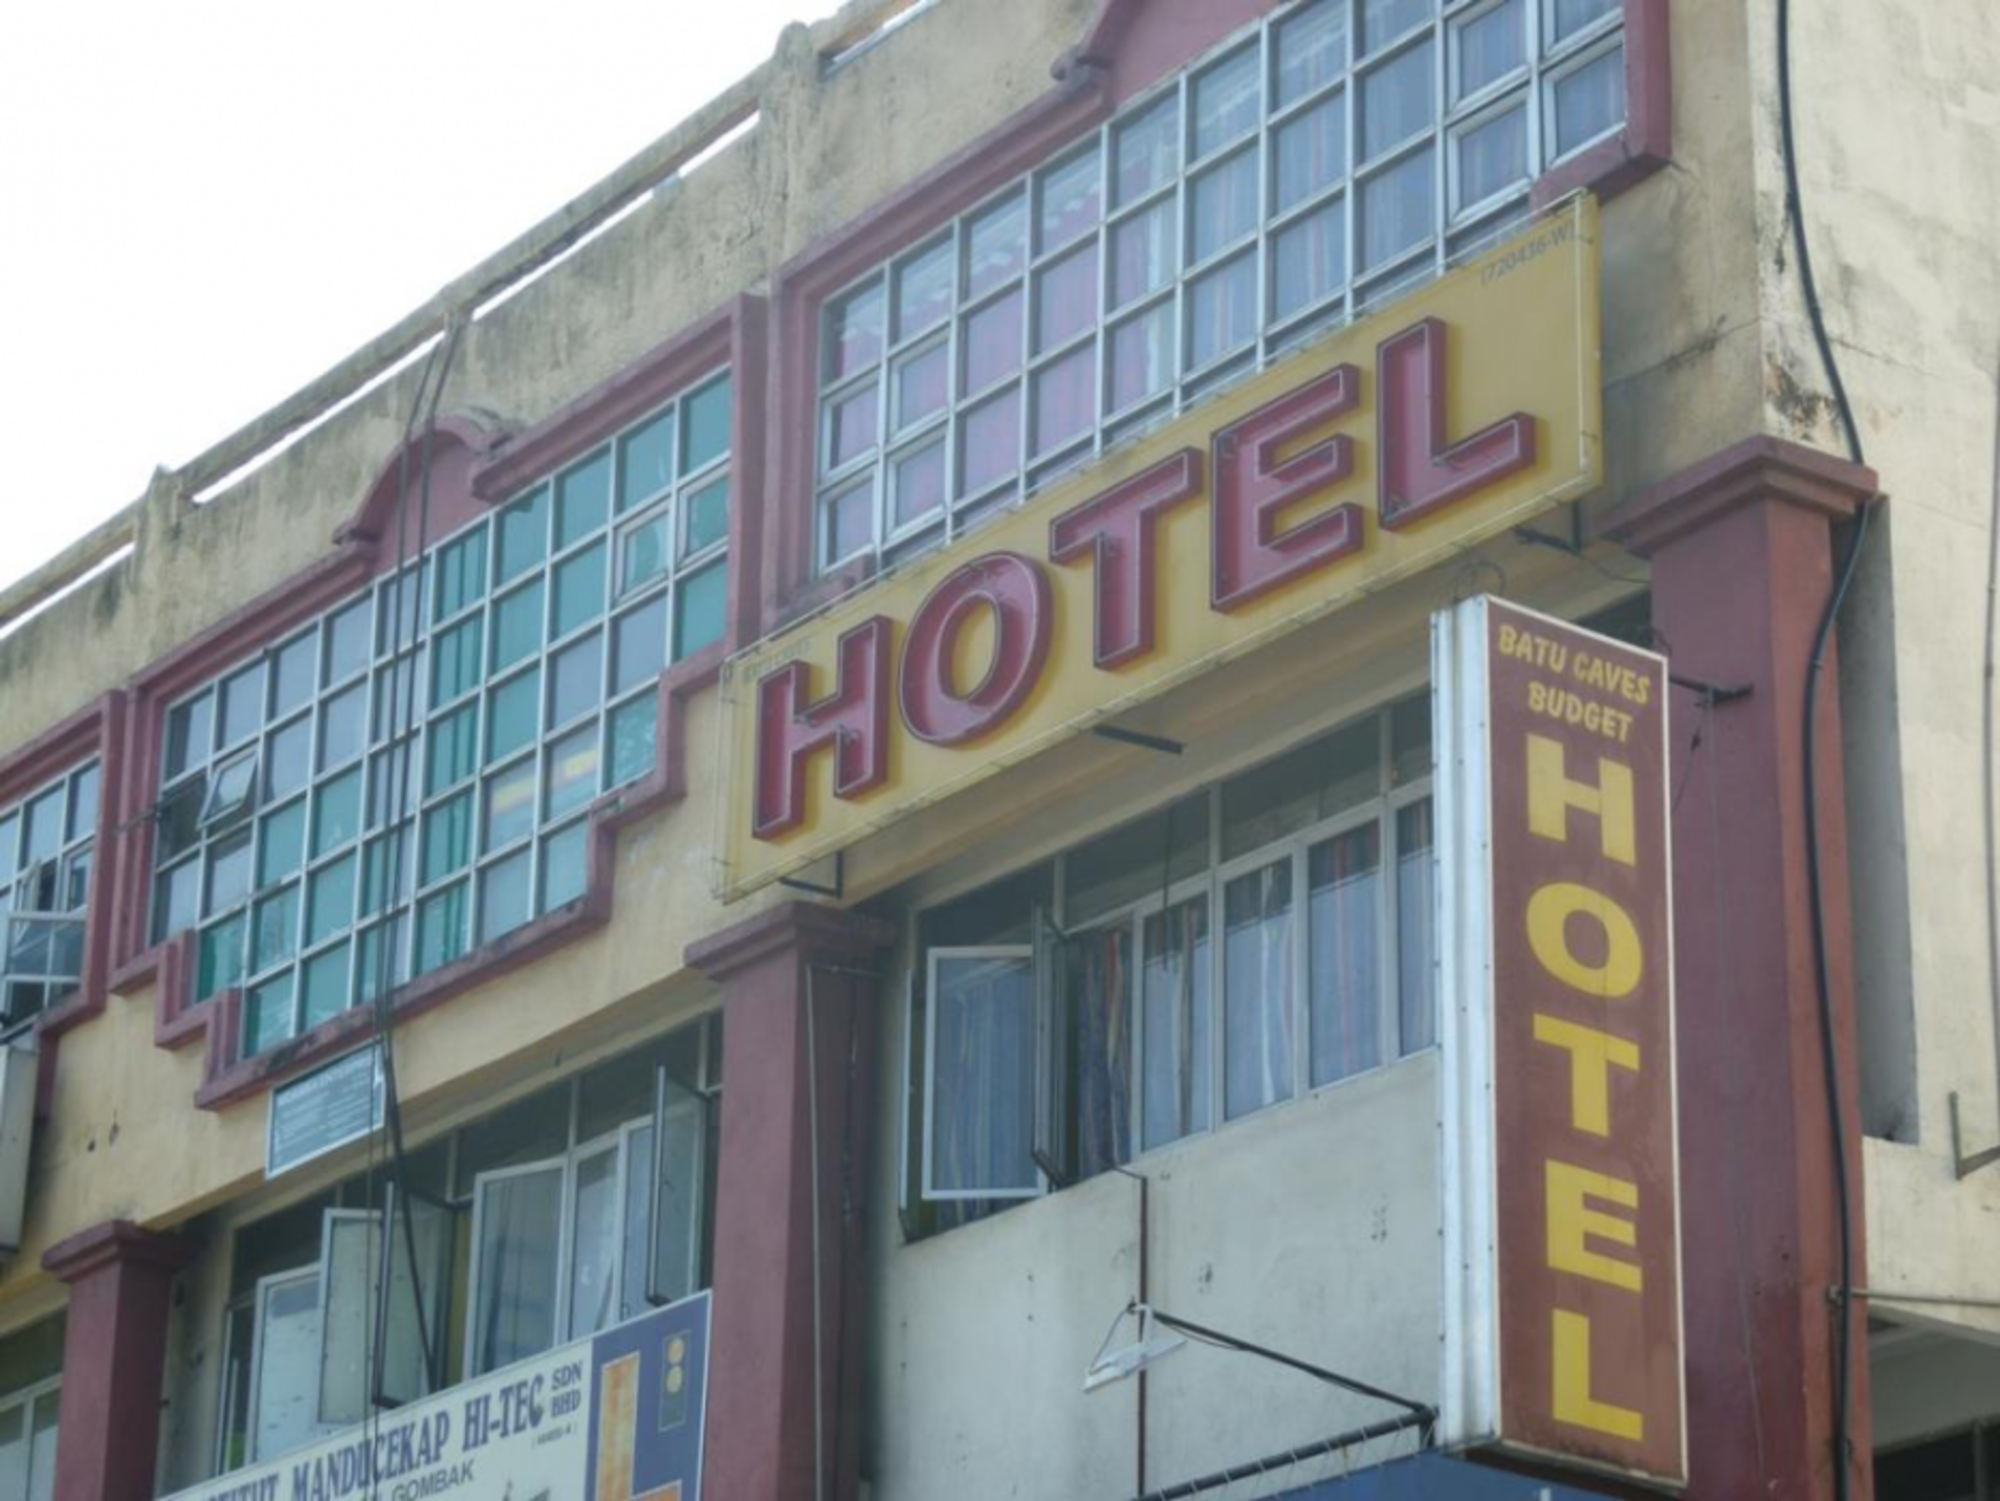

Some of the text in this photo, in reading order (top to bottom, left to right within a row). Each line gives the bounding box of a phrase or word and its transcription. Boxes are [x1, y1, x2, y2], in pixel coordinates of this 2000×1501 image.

[751, 315, 1537, 840] HOTEL
[1498, 623, 1651, 705] BATU CAVES
[1527, 680, 1634, 743] BUDGET
[1525, 732, 1645, 1442] HOTEL
[461, 1373, 544, 1452] HI-TEC
[550, 1361, 583, 1389] SDN
[550, 1390, 583, 1418] BHD
[391, 1459, 476, 1501] GOMBAK
